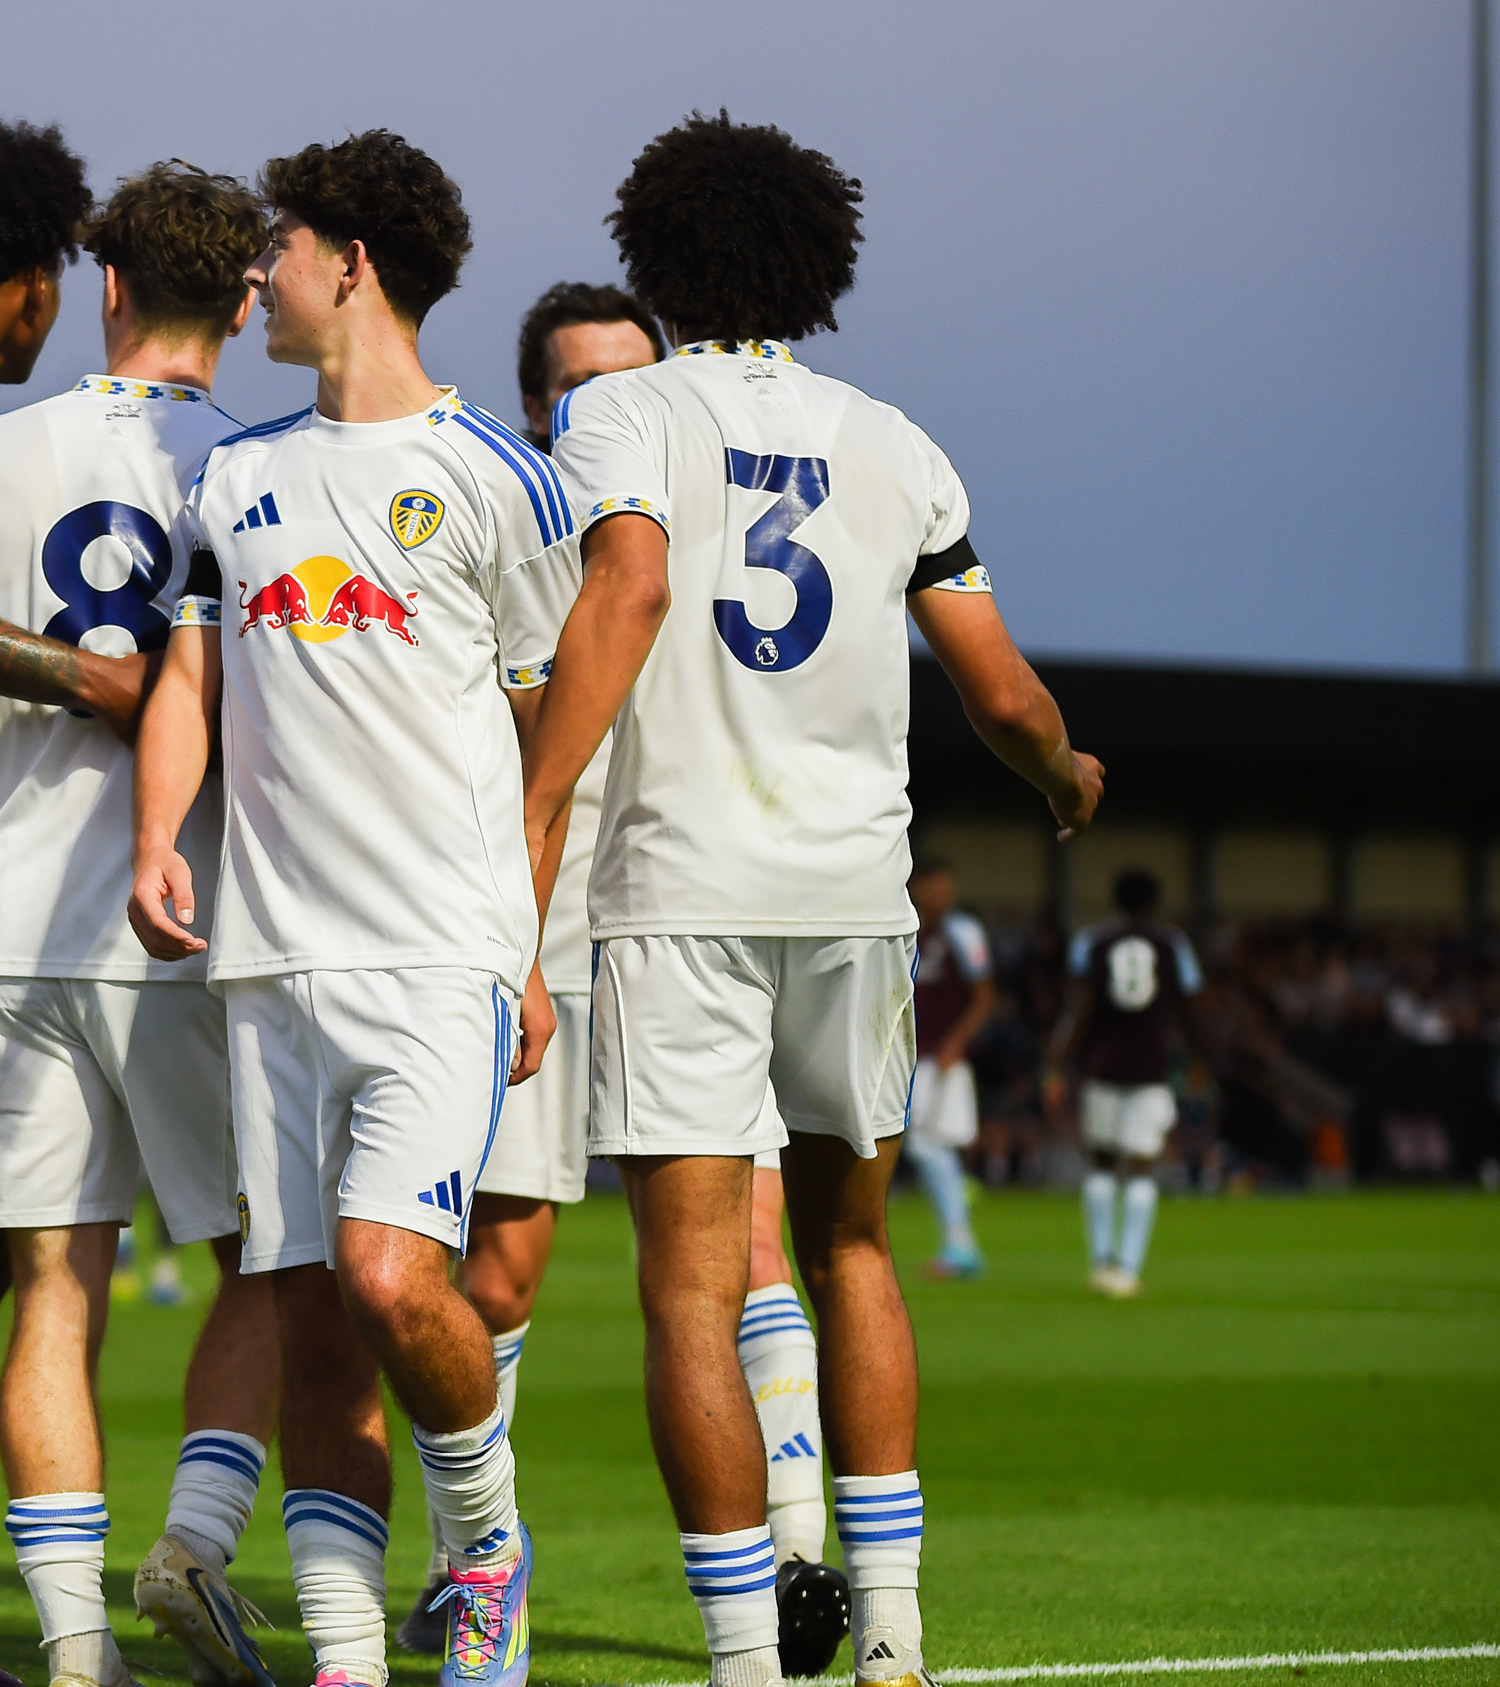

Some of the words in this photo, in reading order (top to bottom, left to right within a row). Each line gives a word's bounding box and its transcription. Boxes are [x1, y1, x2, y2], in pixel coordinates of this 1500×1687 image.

[40, 499, 174, 718] 8
[713, 447, 834, 673] 3
[1107, 936, 1158, 1011] 8
